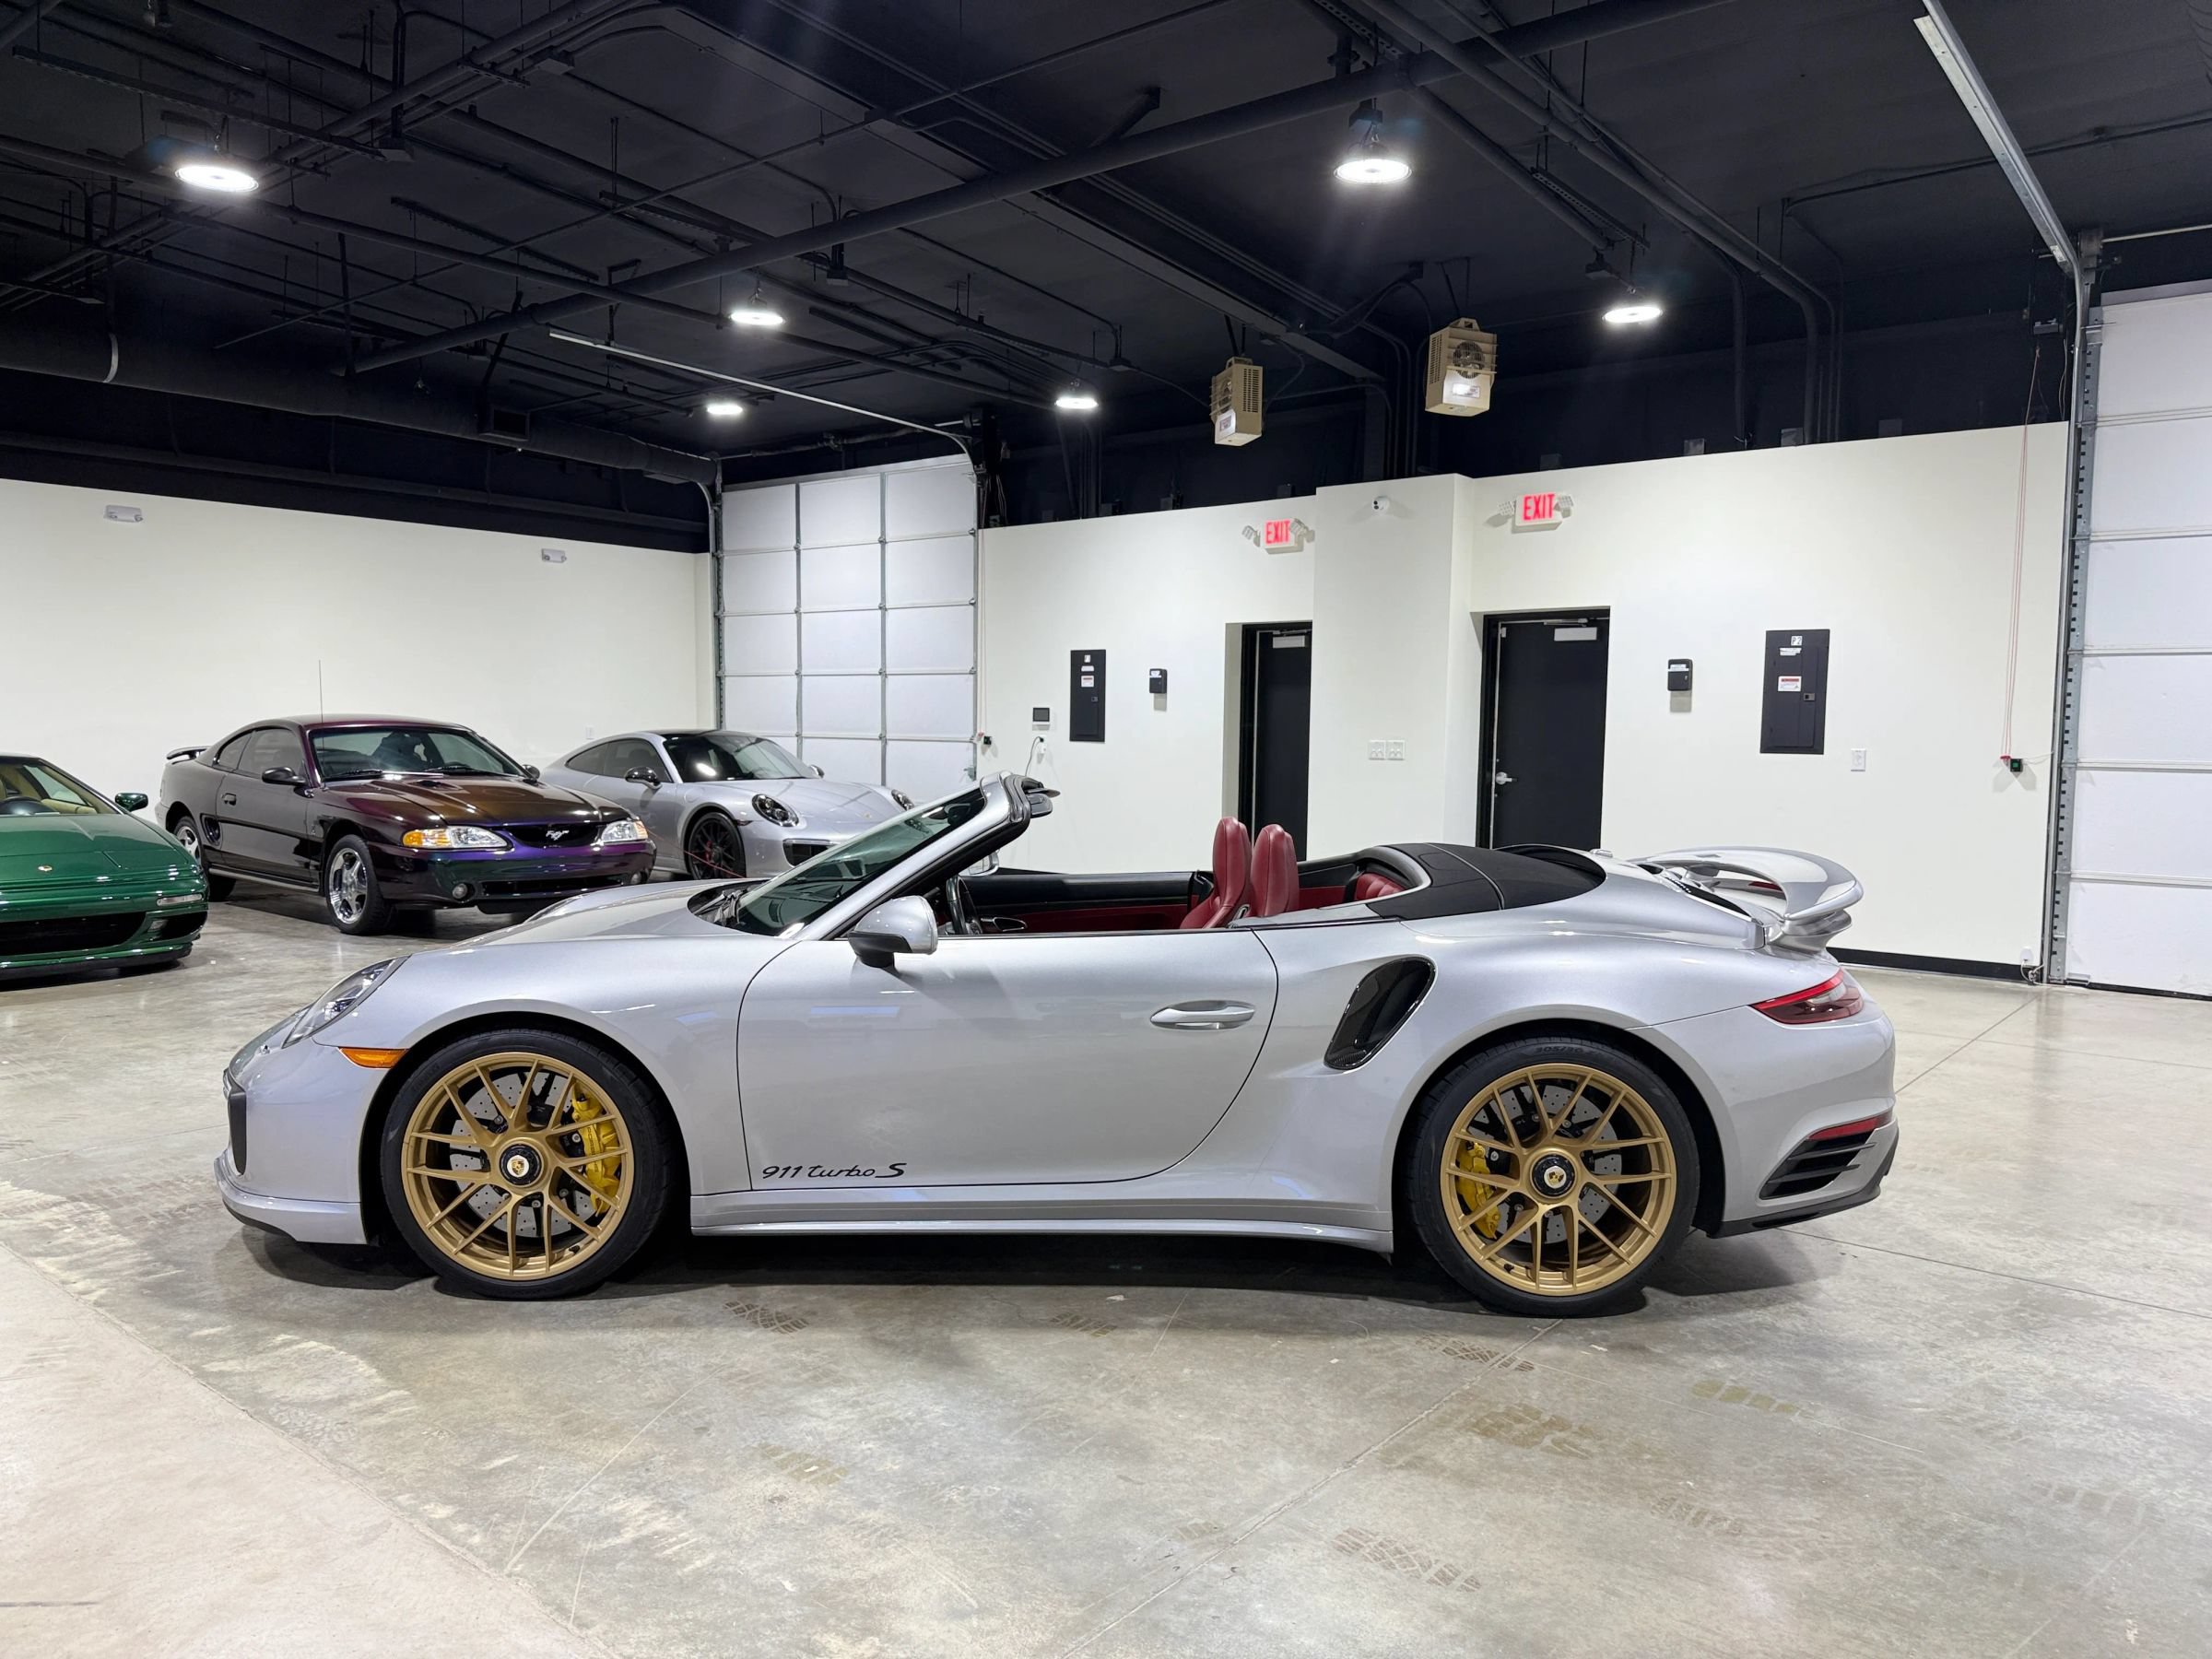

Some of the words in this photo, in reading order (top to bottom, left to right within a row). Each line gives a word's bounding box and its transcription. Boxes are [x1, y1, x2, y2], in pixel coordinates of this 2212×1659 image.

[1524, 493, 1556, 521] EXIT
[1265, 520, 1290, 545] EXIT
[762, 1165, 803, 1179] 911
[807, 1164, 876, 1178] turbo
[875, 1162, 907, 1179] S
